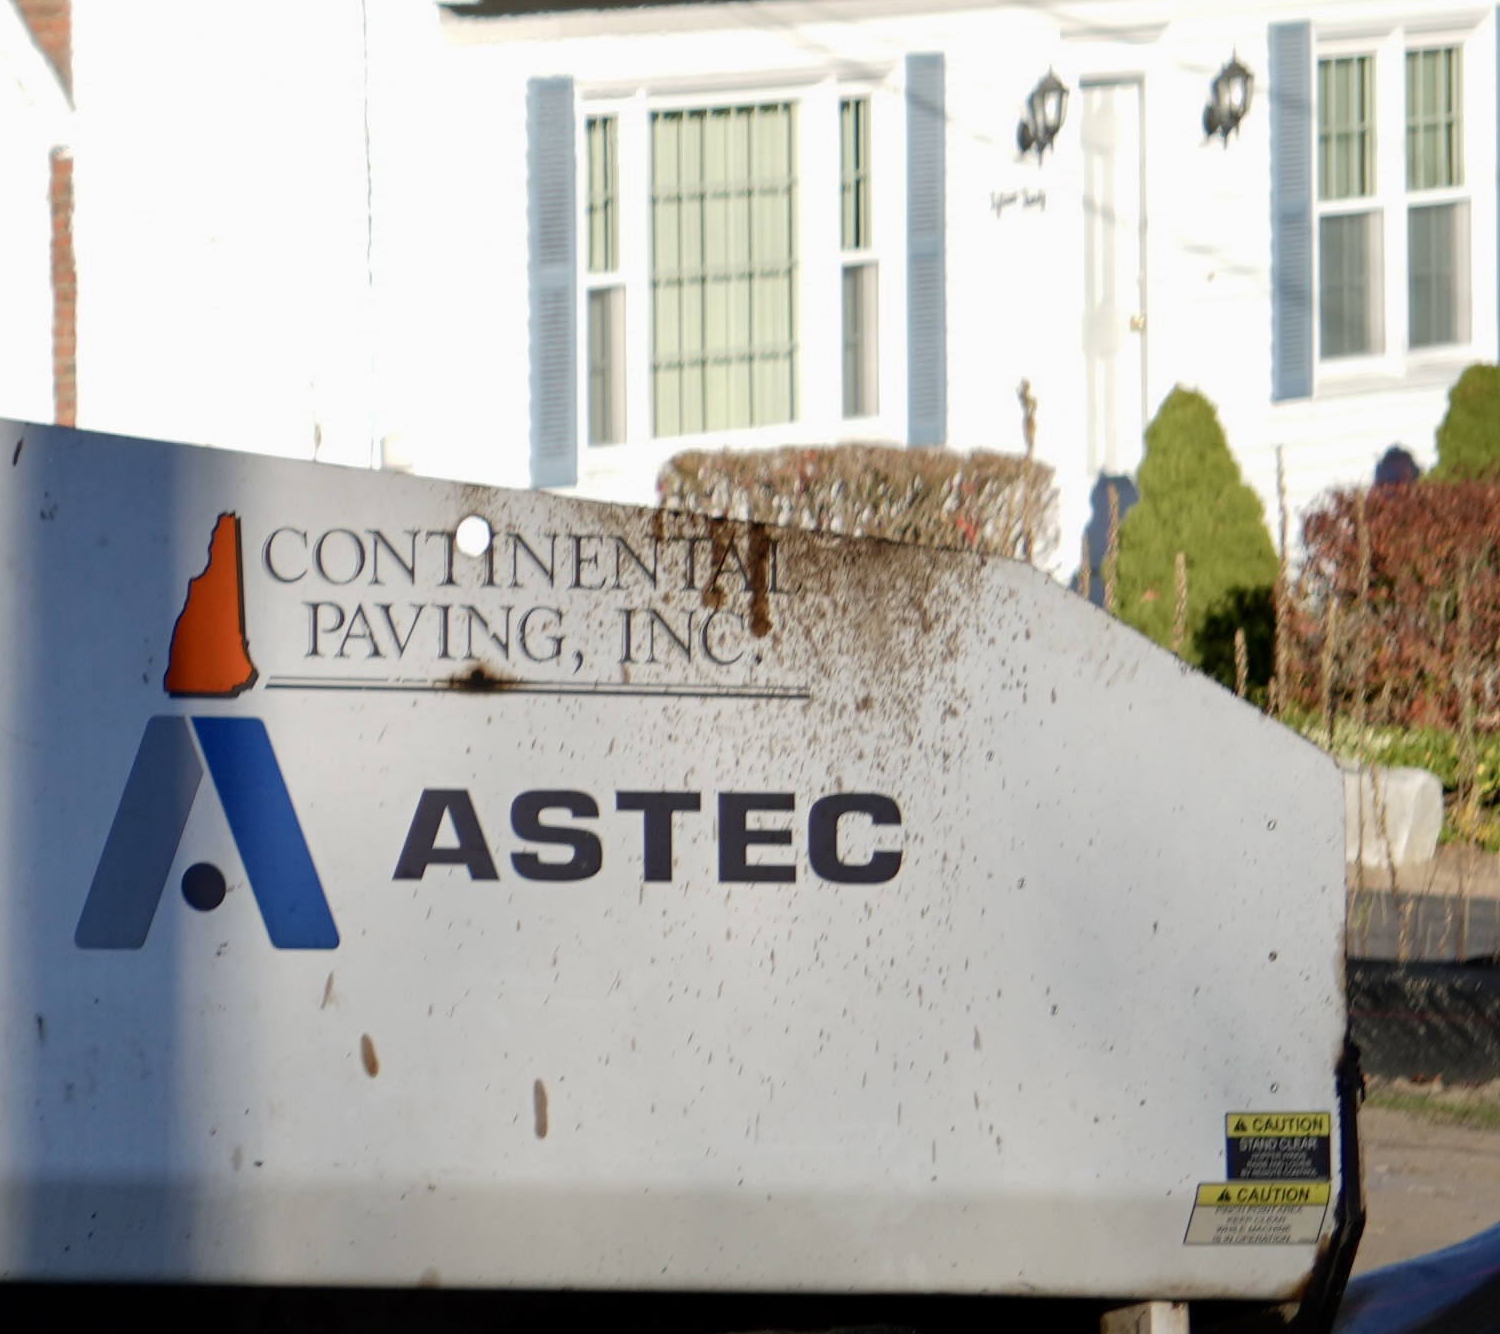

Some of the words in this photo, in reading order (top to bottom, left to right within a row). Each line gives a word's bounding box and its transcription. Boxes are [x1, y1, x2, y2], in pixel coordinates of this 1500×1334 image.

[261, 525, 802, 594] CONTINENTAL
[302, 601, 583, 675] PAVING,
[619, 607, 762, 666] INC.
[391, 787, 903, 884] ASTEC
[1252, 1117, 1323, 1132] CAUTION
[1236, 1186, 1310, 1203] CAUTION
